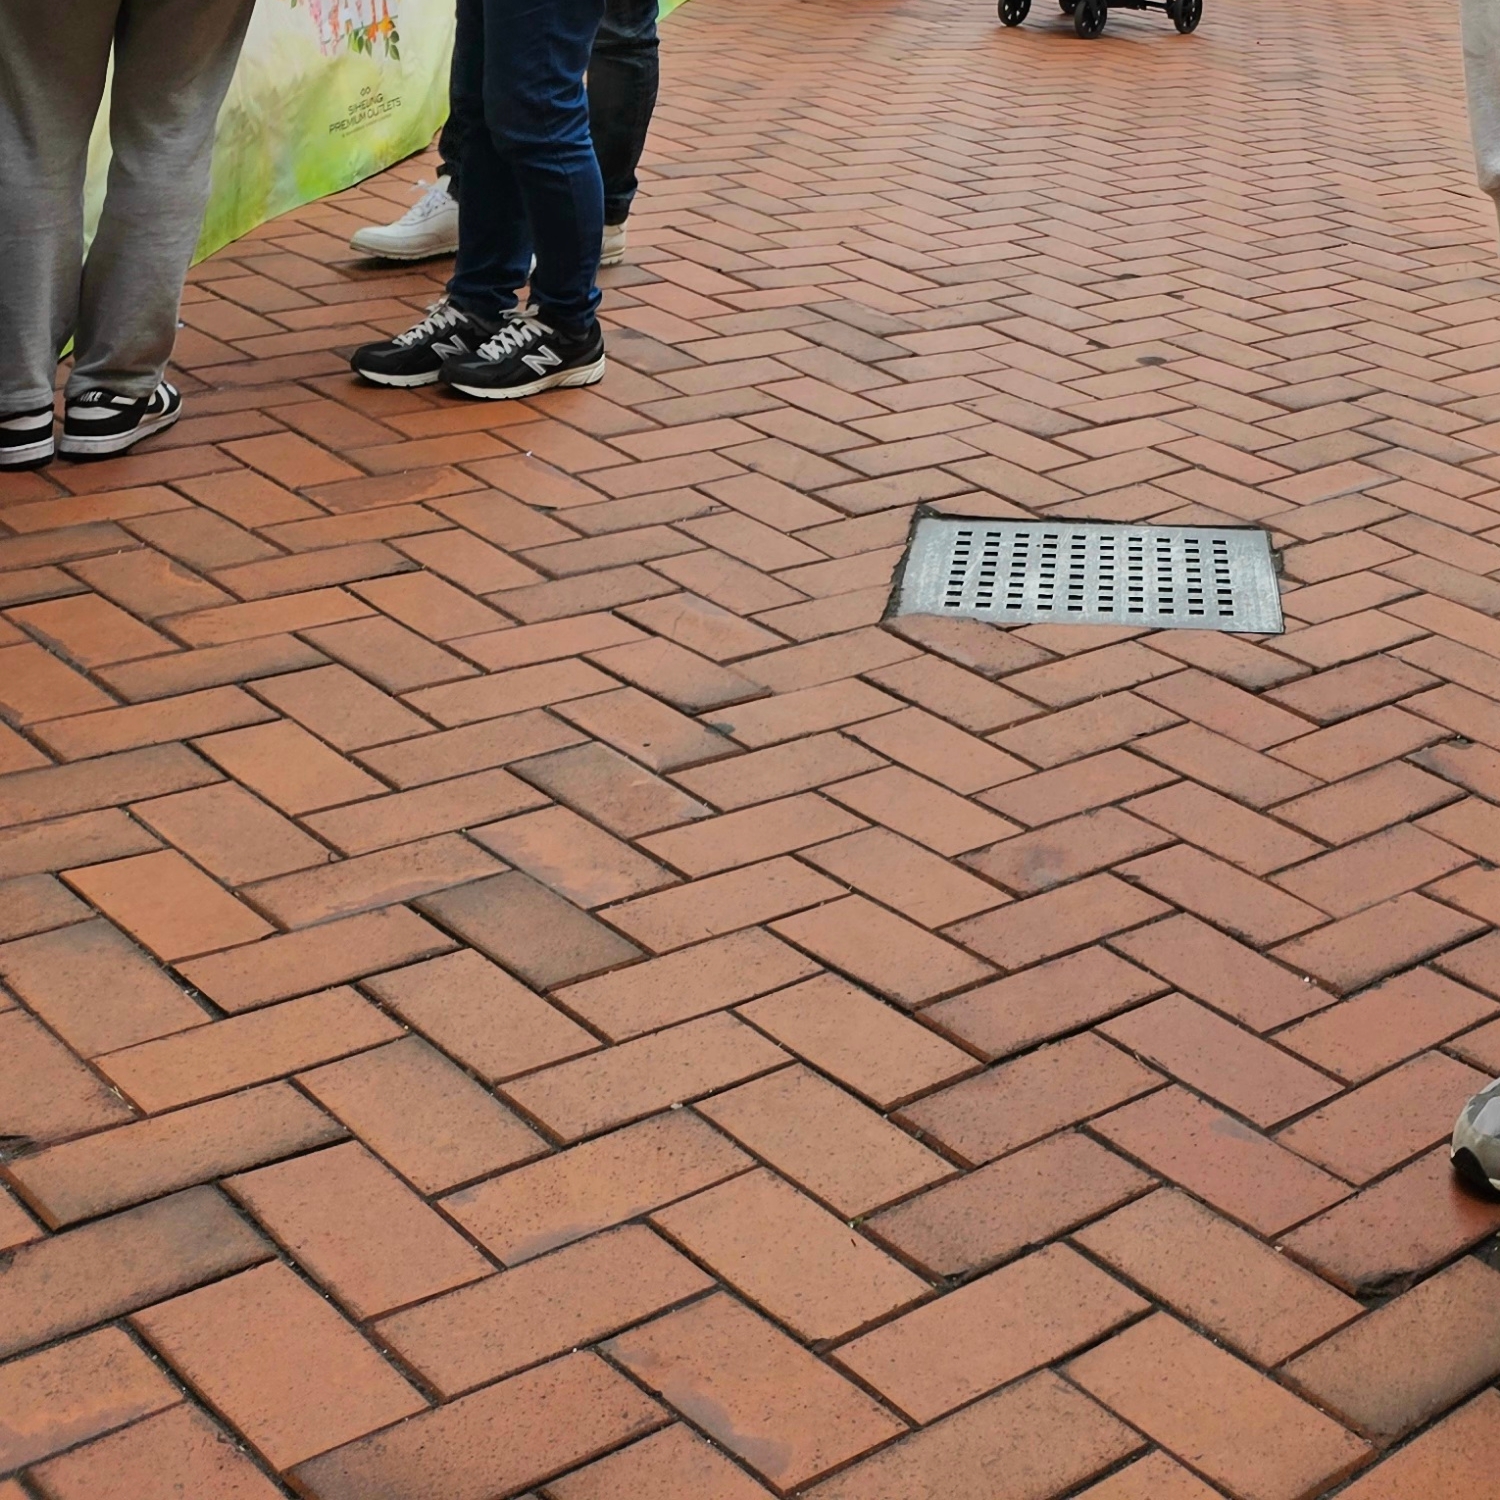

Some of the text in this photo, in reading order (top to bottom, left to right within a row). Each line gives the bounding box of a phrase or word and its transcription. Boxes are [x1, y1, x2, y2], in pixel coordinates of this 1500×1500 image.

[329, 110, 366, 135] PREMIUM
[367, 96, 402, 119] OUTLETS
[521, 345, 562, 376] N
